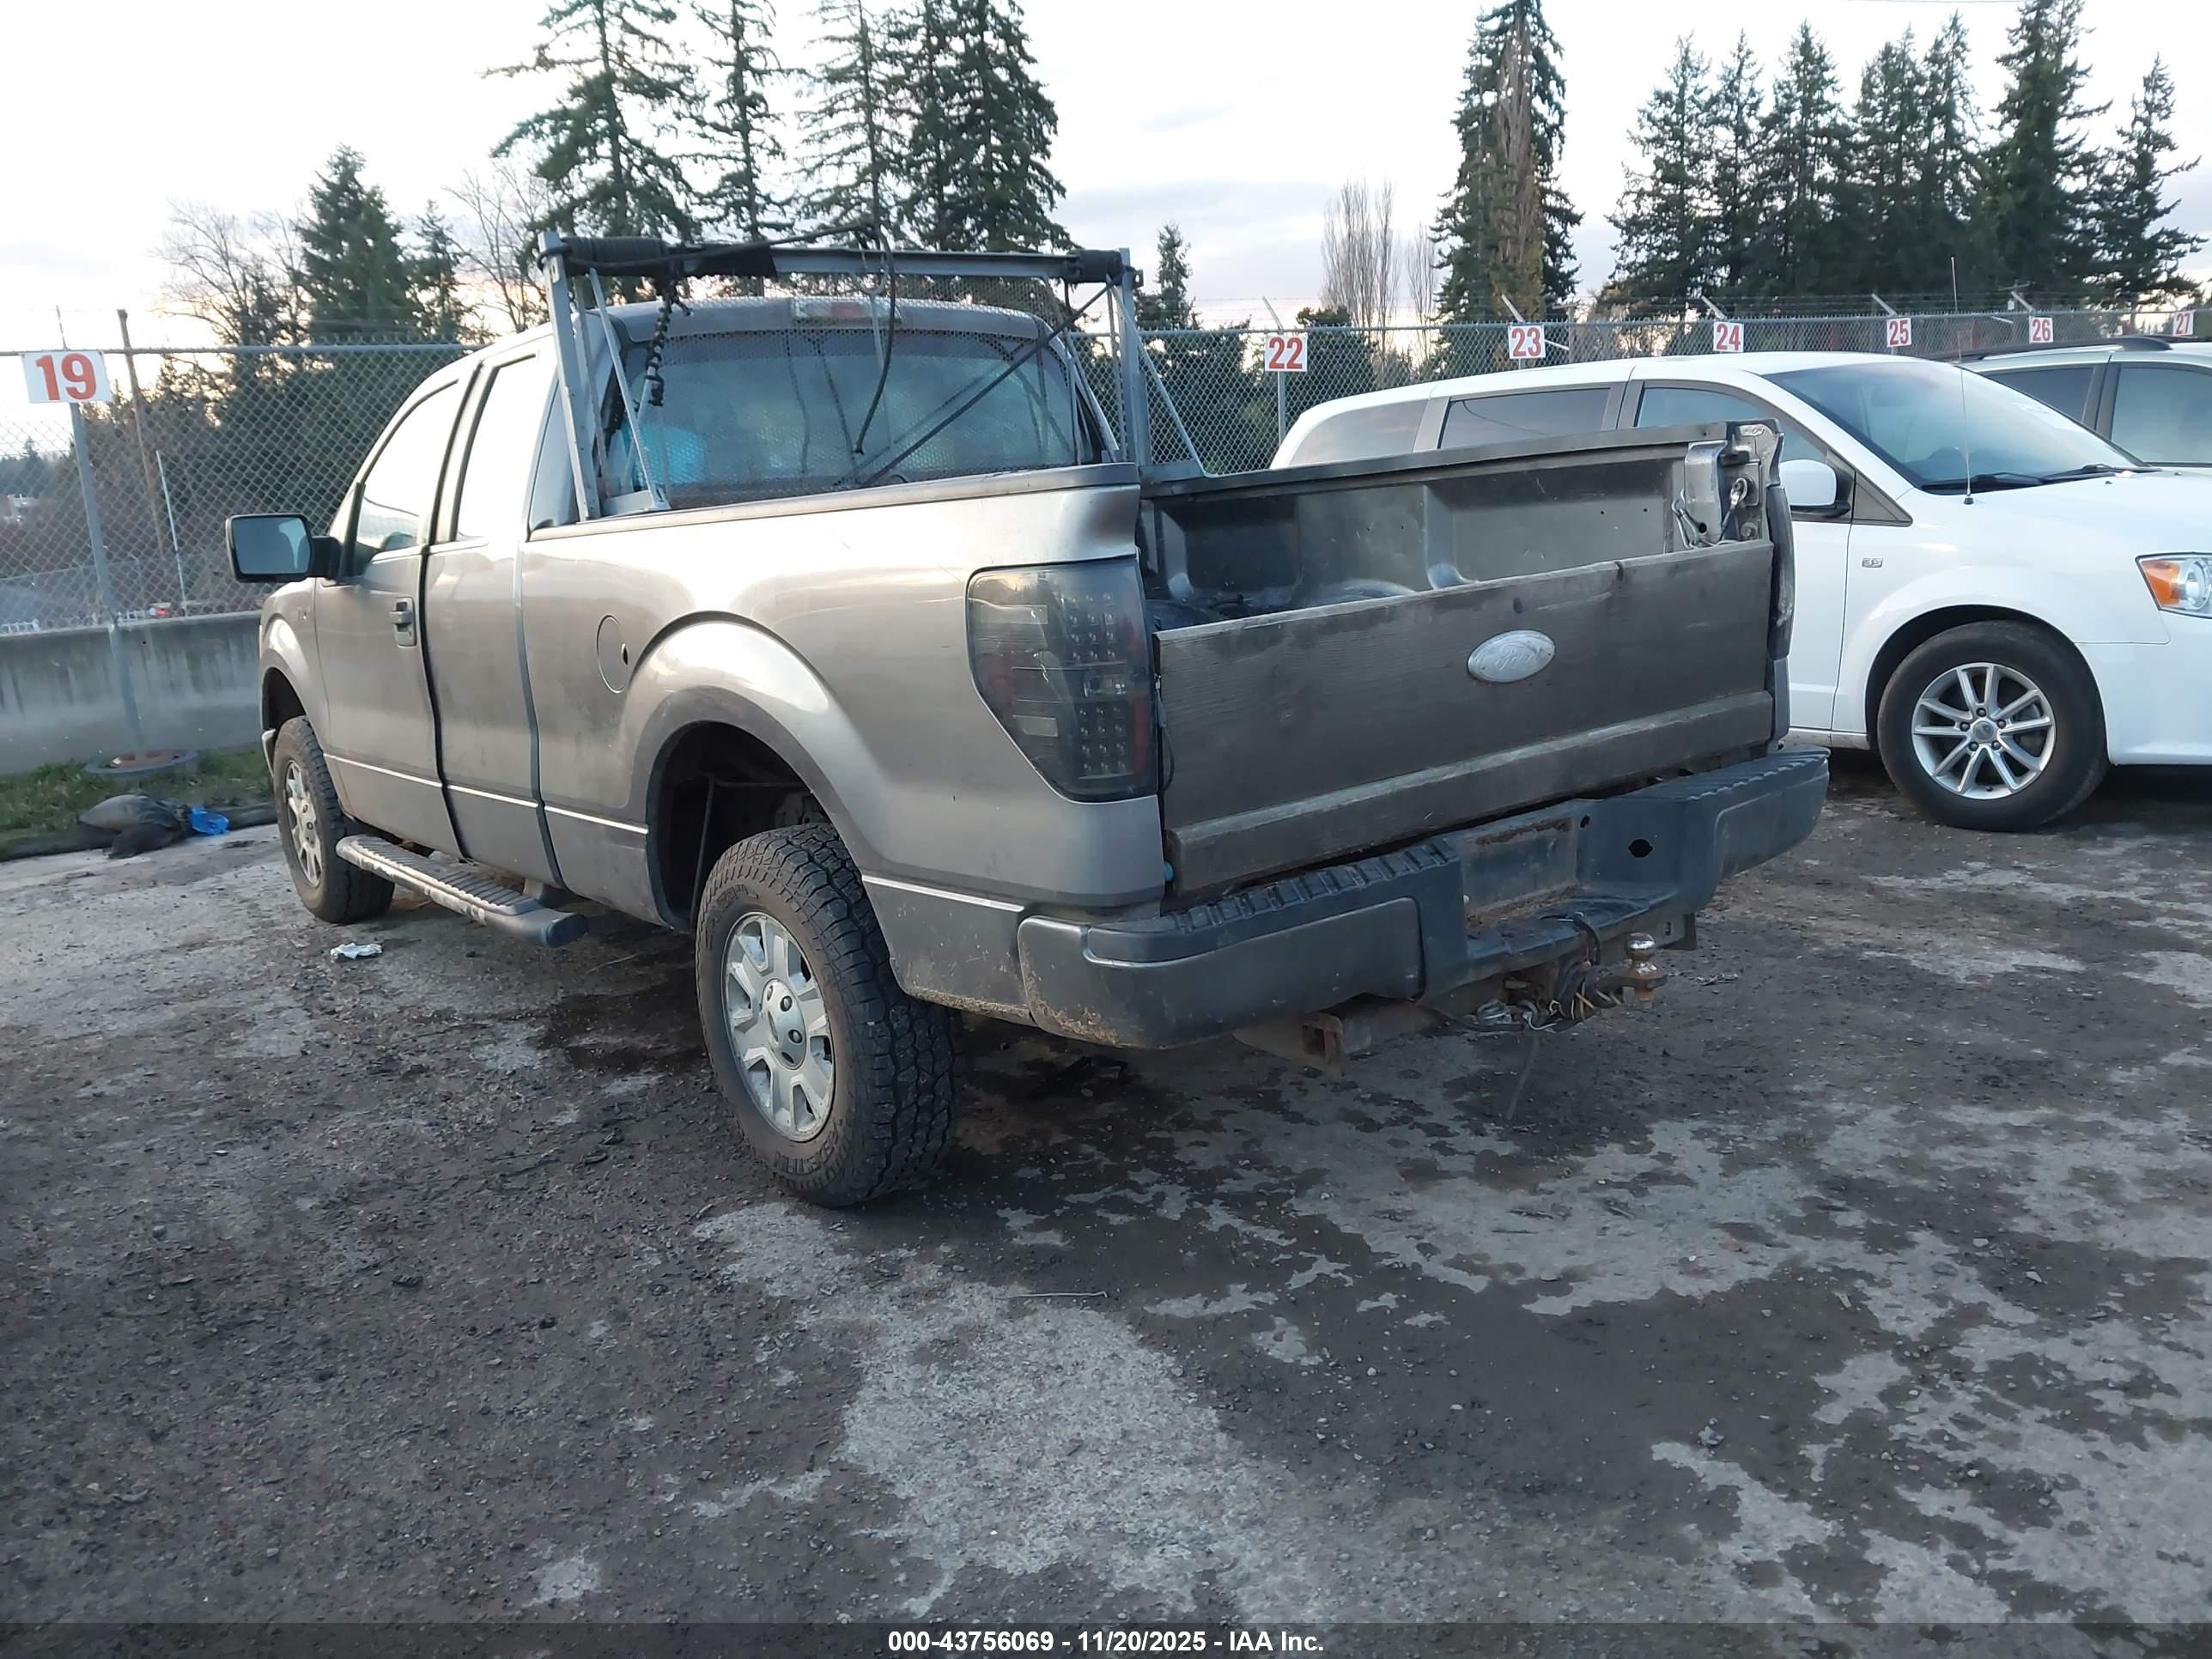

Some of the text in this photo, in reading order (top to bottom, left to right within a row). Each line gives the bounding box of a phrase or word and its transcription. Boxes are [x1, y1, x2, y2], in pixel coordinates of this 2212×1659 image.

[1717, 323, 1741, 351] 24
[1889, 319, 1909, 345] 25
[2033, 319, 2051, 341] 26
[2176, 313, 2191, 334] 27
[1268, 336, 1303, 370] 22
[1511, 327, 1542, 357] 23
[35, 353, 96, 401] 19
[1495, 641, 1543, 672] Ford
